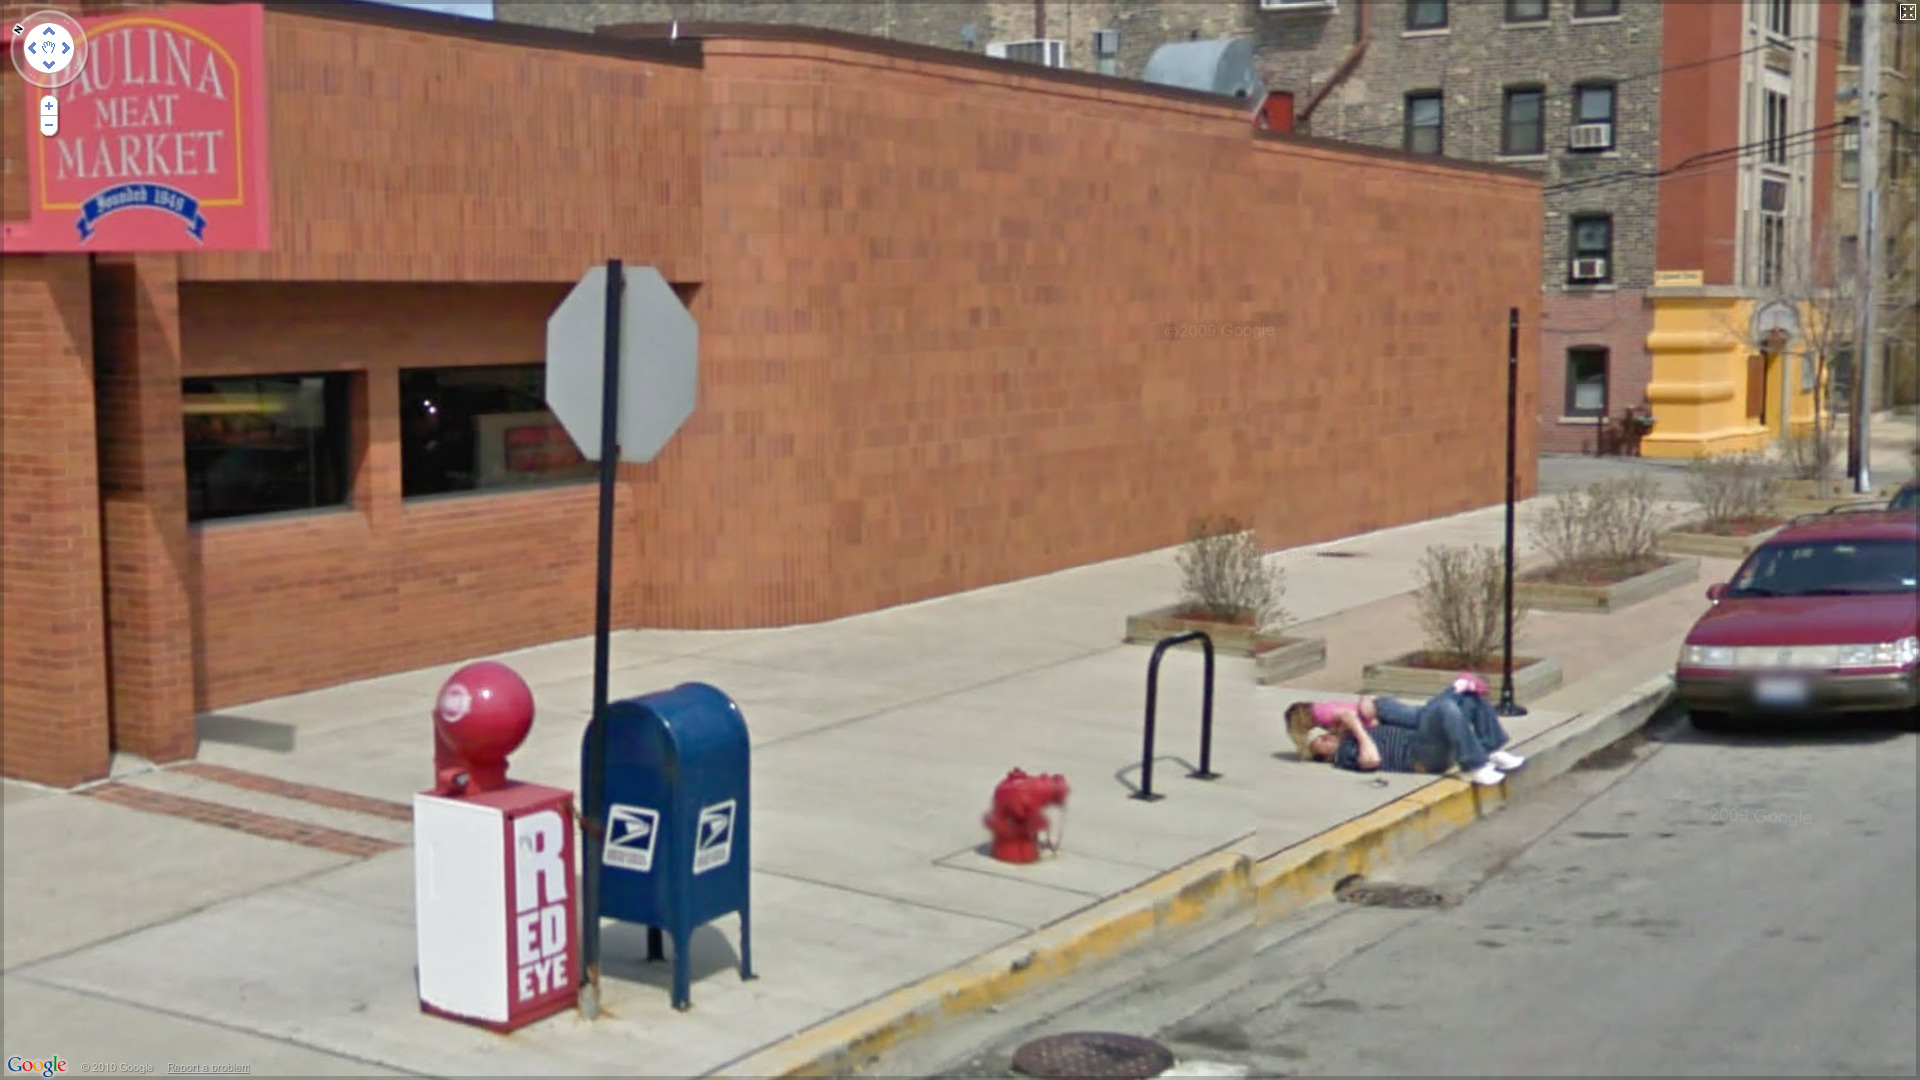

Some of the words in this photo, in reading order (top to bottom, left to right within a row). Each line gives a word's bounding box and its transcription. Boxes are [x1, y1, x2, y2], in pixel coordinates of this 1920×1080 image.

[95, 94, 180, 129] MEAT
[56, 129, 225, 181] MARKET
[518, 952, 568, 1001] EYE
